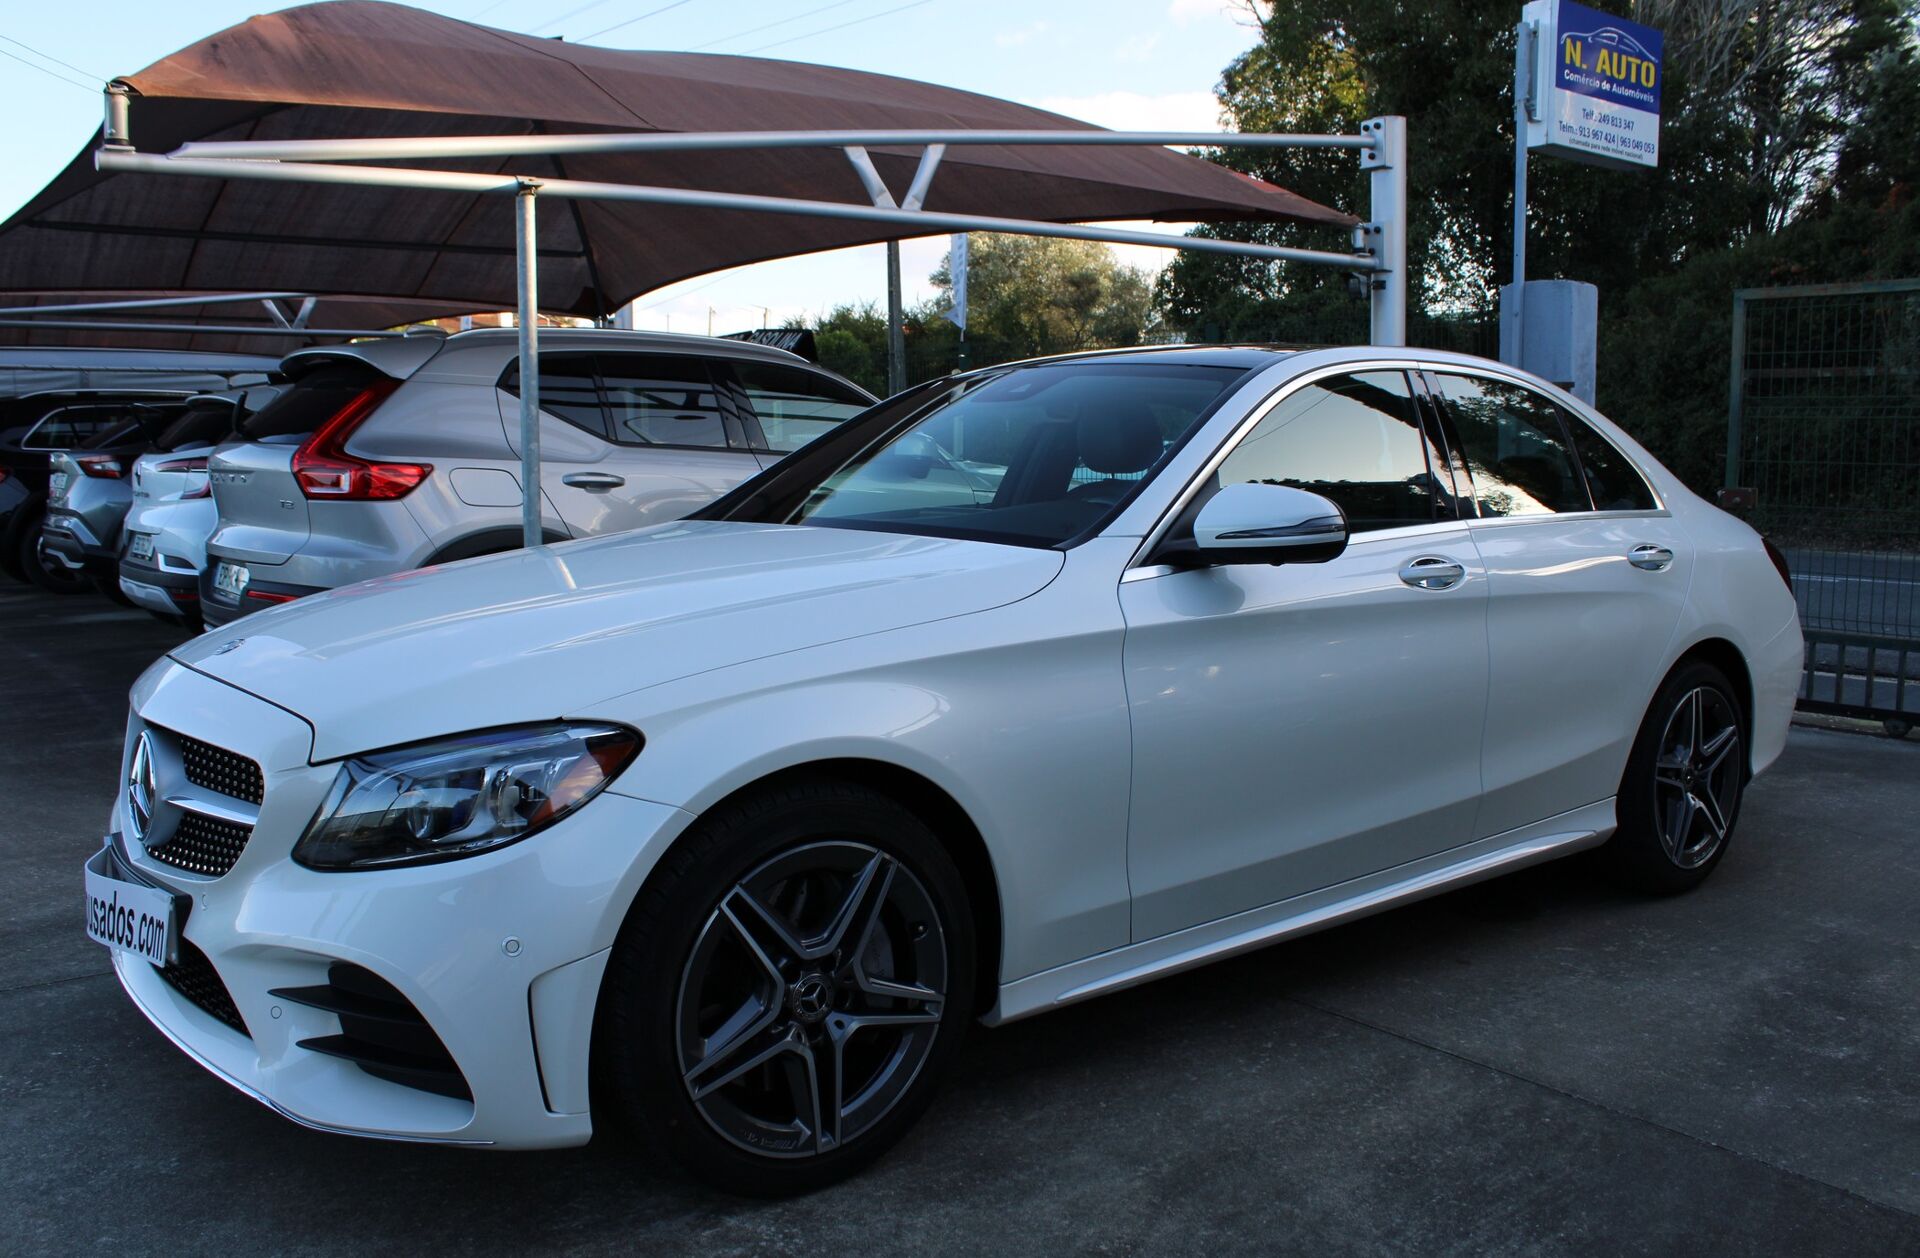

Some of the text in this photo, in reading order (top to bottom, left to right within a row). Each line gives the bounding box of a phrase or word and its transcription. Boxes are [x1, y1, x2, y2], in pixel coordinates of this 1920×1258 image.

[1564, 38, 1656, 88] N. AUTO
[1564, 69, 1654, 103] Comércio de Automóveis
[1598, 113, 1610, 125] 249
[1611, 116, 1622, 128] 813
[1623, 119, 1635, 131] 347
[1579, 125, 1590, 138] 913
[1591, 129, 1603, 141] 967
[1604, 132, 1616, 144] 424
[1620, 136, 1631, 148] 963
[1632, 139, 1643, 151] 049
[1644, 142, 1655, 154] 053
[750, 331, 803, 351] GASOLINA
